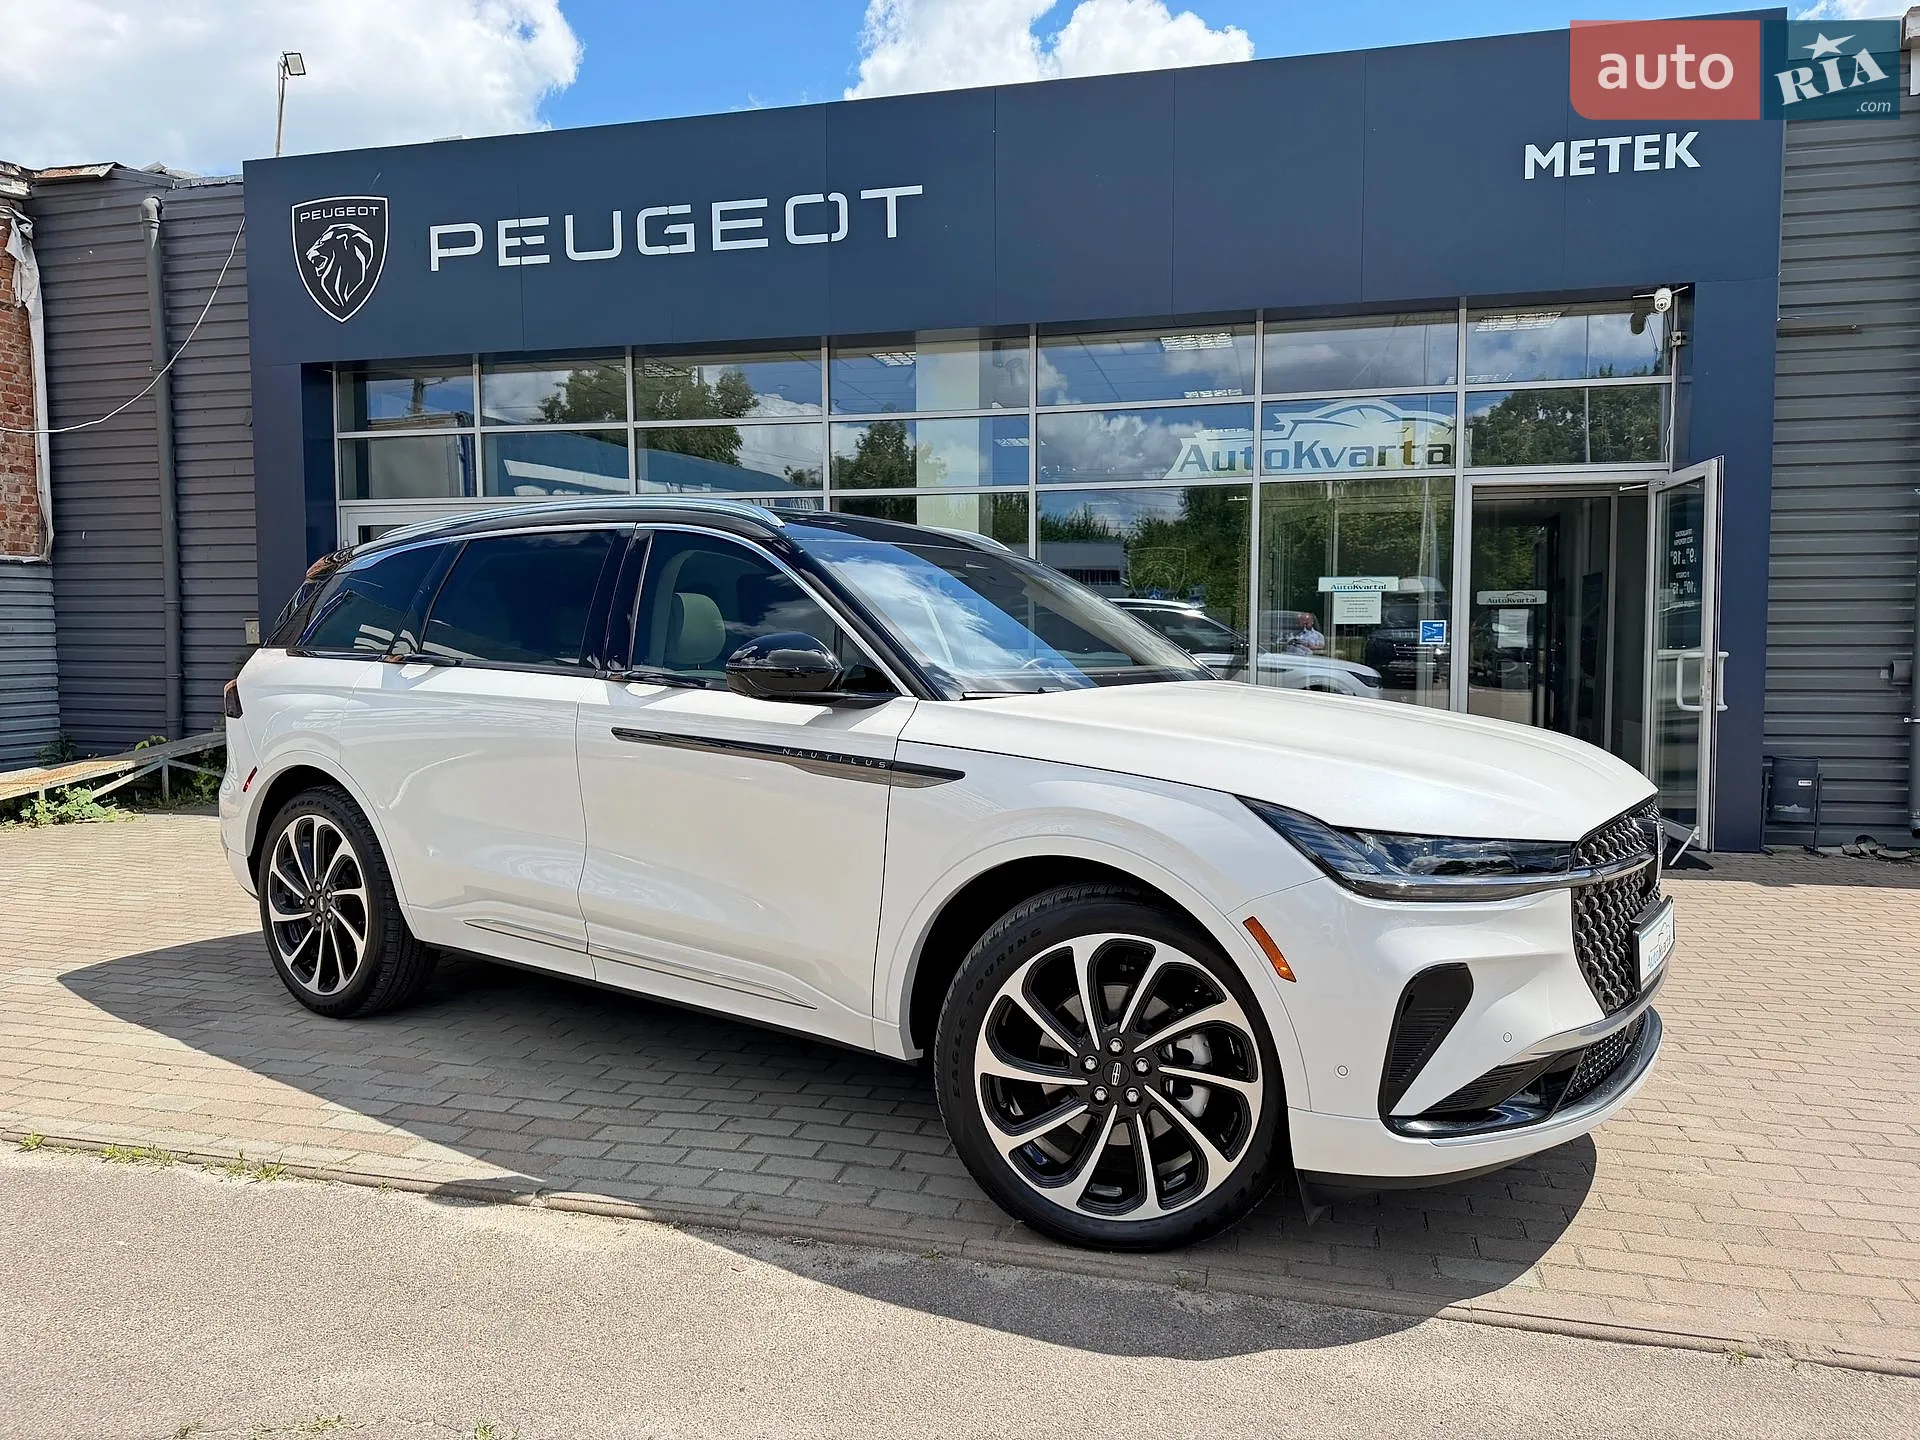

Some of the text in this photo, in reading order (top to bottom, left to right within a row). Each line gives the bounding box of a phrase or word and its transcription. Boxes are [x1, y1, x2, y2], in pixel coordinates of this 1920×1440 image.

[1524, 131, 1701, 180] METEK
[299, 205, 380, 223] PEUGEOT
[430, 184, 923, 272] PEUGEOT
[1177, 440, 1452, 473] AutoKvarta
[1330, 583, 1387, 591] AutoKvartal
[782, 748, 887, 769] NAUTILUS
[967, 926, 1043, 1007] TOURING
